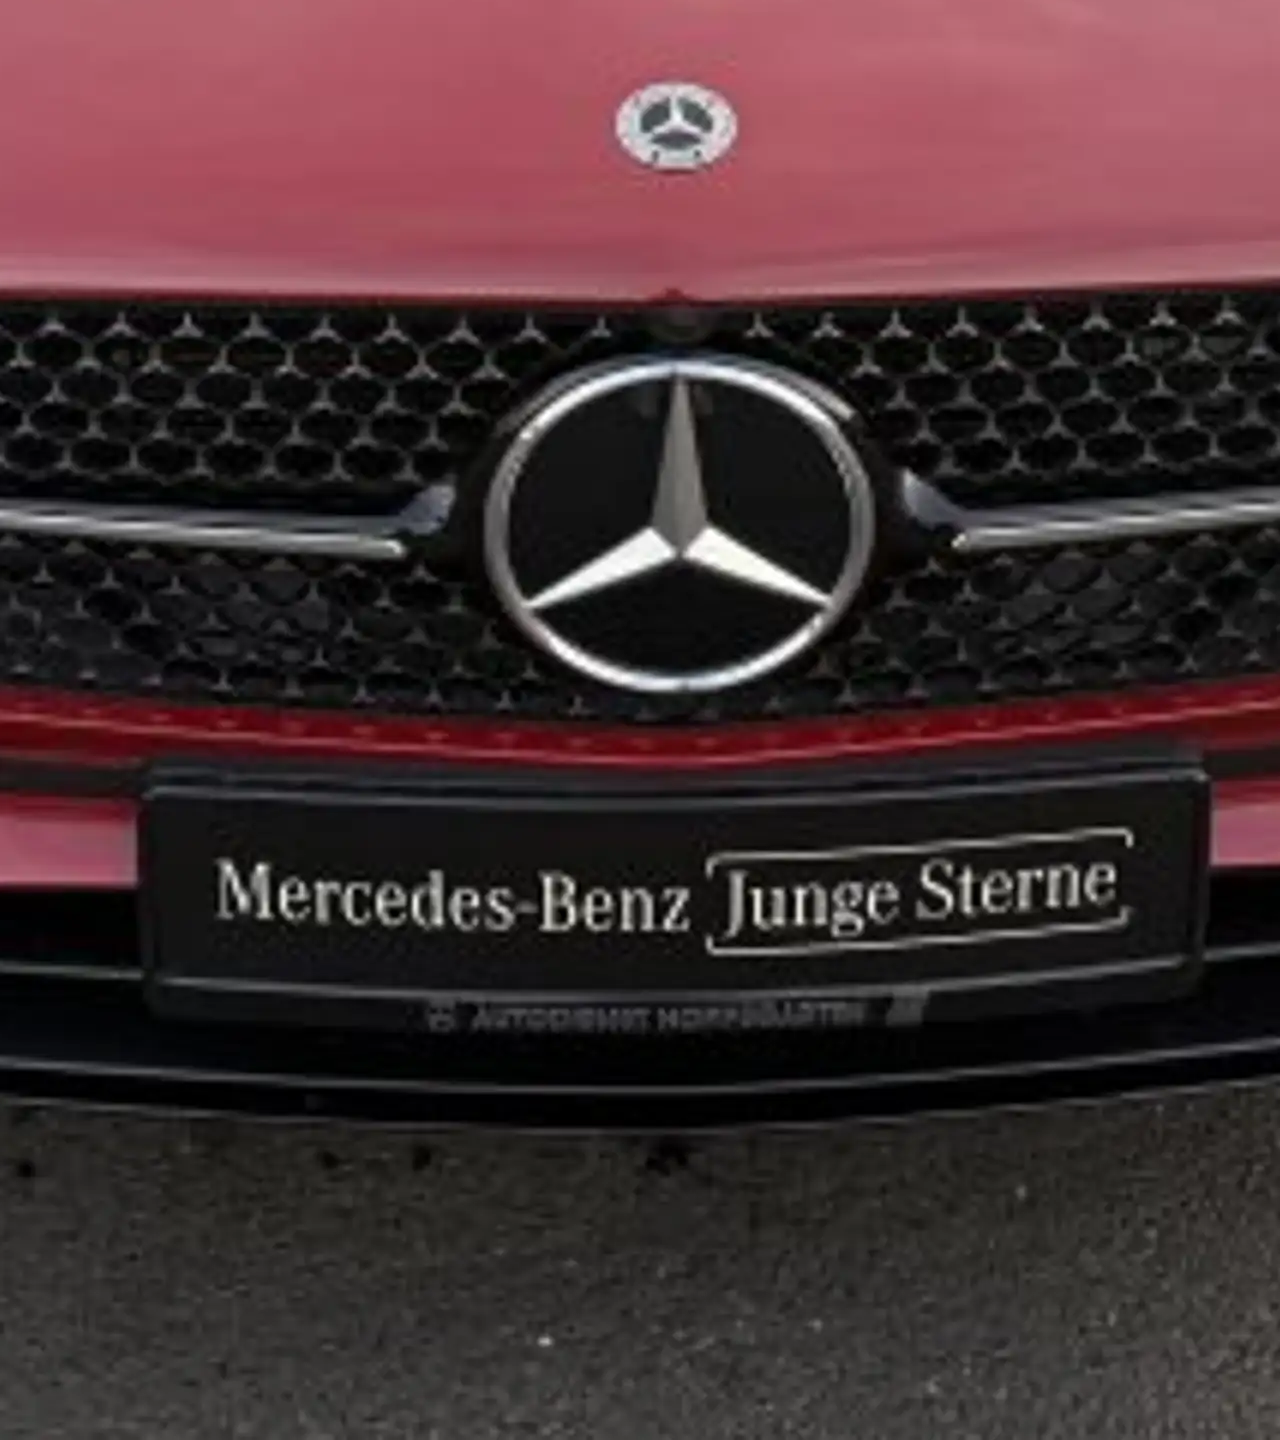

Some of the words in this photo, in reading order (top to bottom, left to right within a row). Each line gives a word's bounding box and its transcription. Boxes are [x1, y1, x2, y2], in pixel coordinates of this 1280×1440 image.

[217, 858, 691, 932] Mercedes-Benz
[725, 869, 900, 938] Junge
[916, 858, 1117, 920] Sterne
